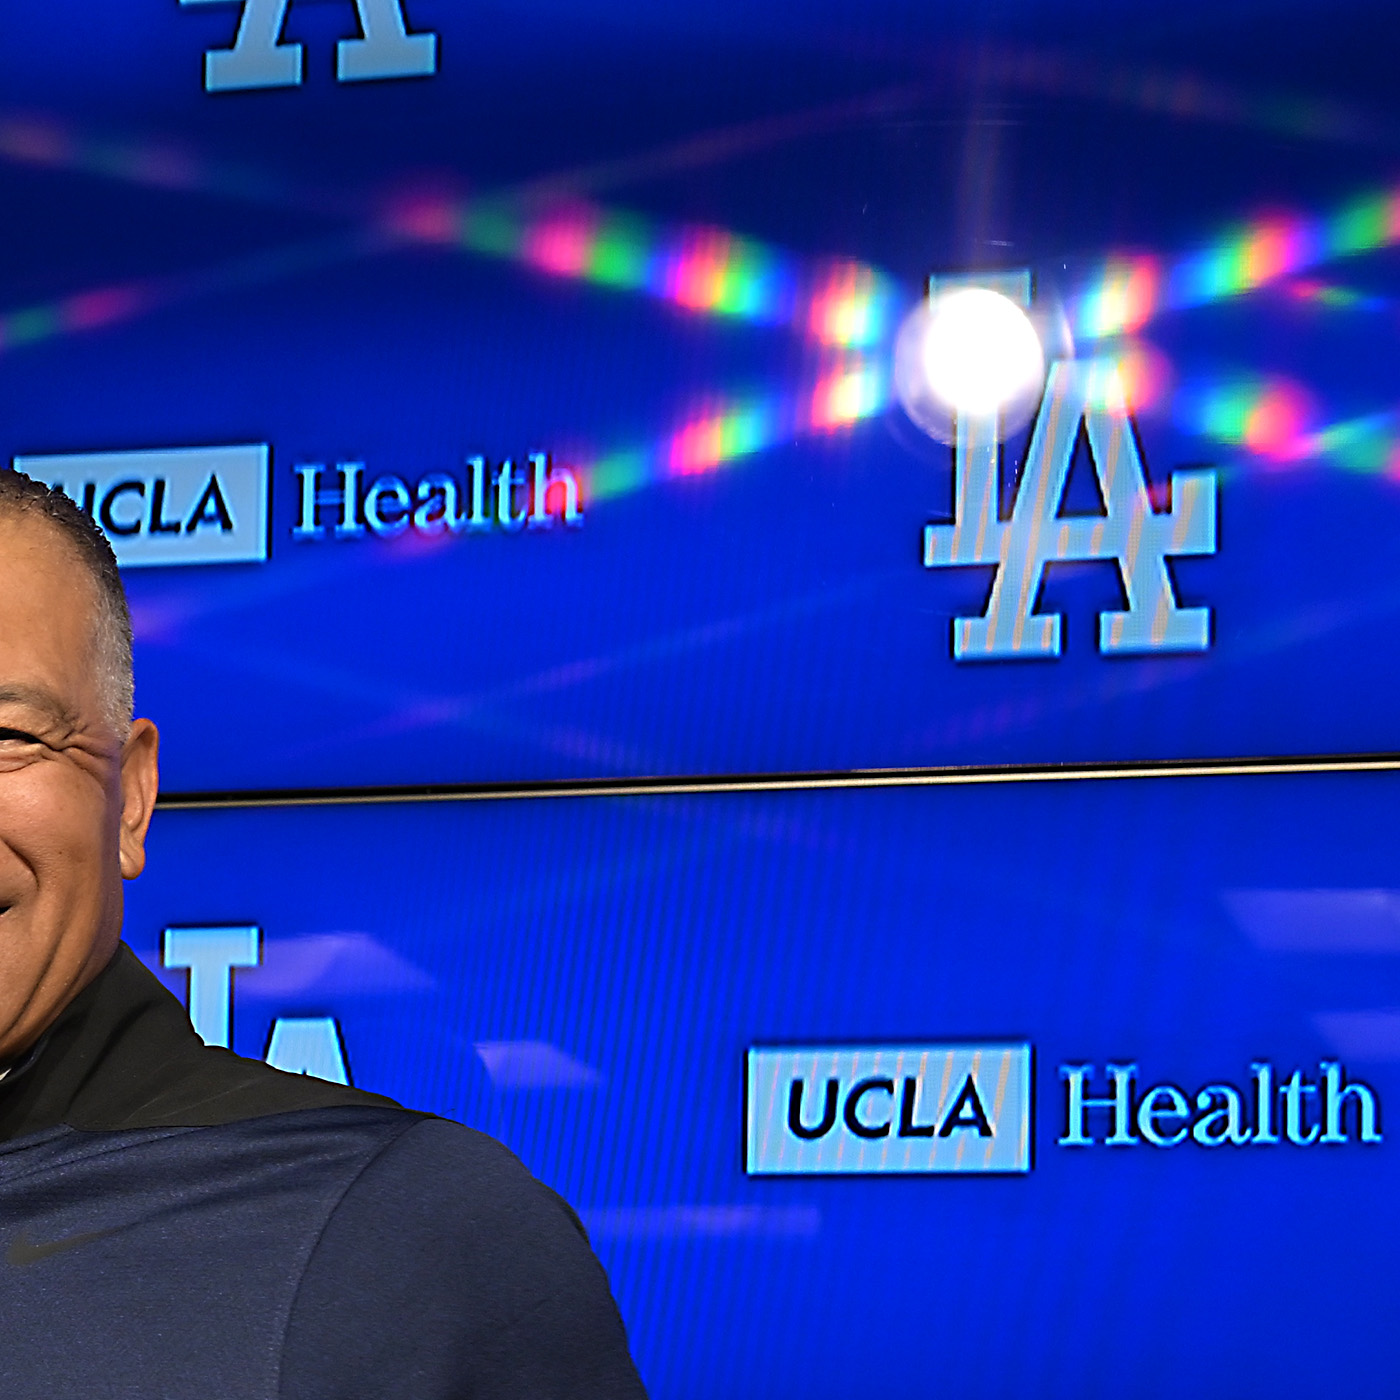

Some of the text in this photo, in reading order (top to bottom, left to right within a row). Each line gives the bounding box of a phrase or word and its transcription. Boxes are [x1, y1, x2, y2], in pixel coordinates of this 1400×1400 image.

[291, 450, 584, 541] Health
[924, 271, 1217, 661] LA
[786, 1060, 1383, 1147] UCLA Health
